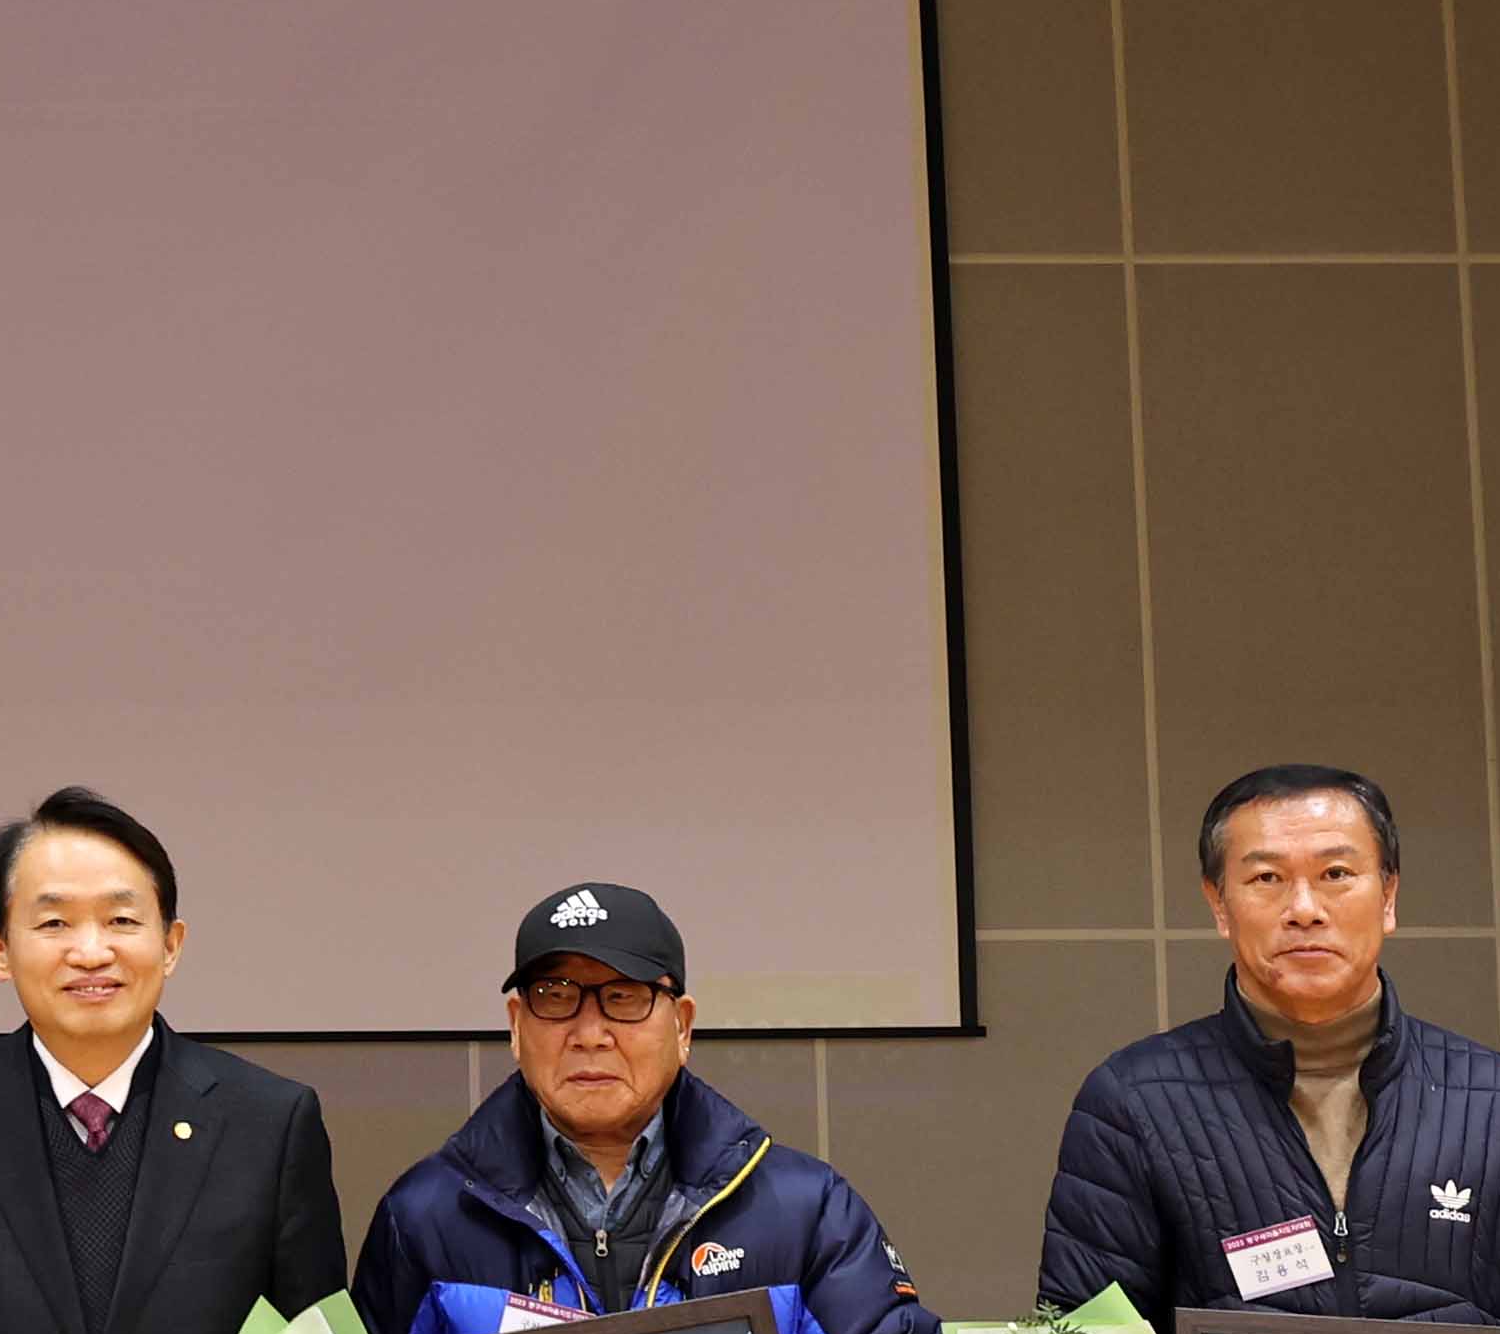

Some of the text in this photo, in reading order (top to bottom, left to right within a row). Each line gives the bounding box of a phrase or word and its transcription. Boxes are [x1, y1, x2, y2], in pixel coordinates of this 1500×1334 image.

[550, 906, 608, 924] adidas
[1429, 1208, 1471, 1223] adidas
[709, 1247, 745, 1264] Lowe
[701, 1257, 741, 1276] alpine
